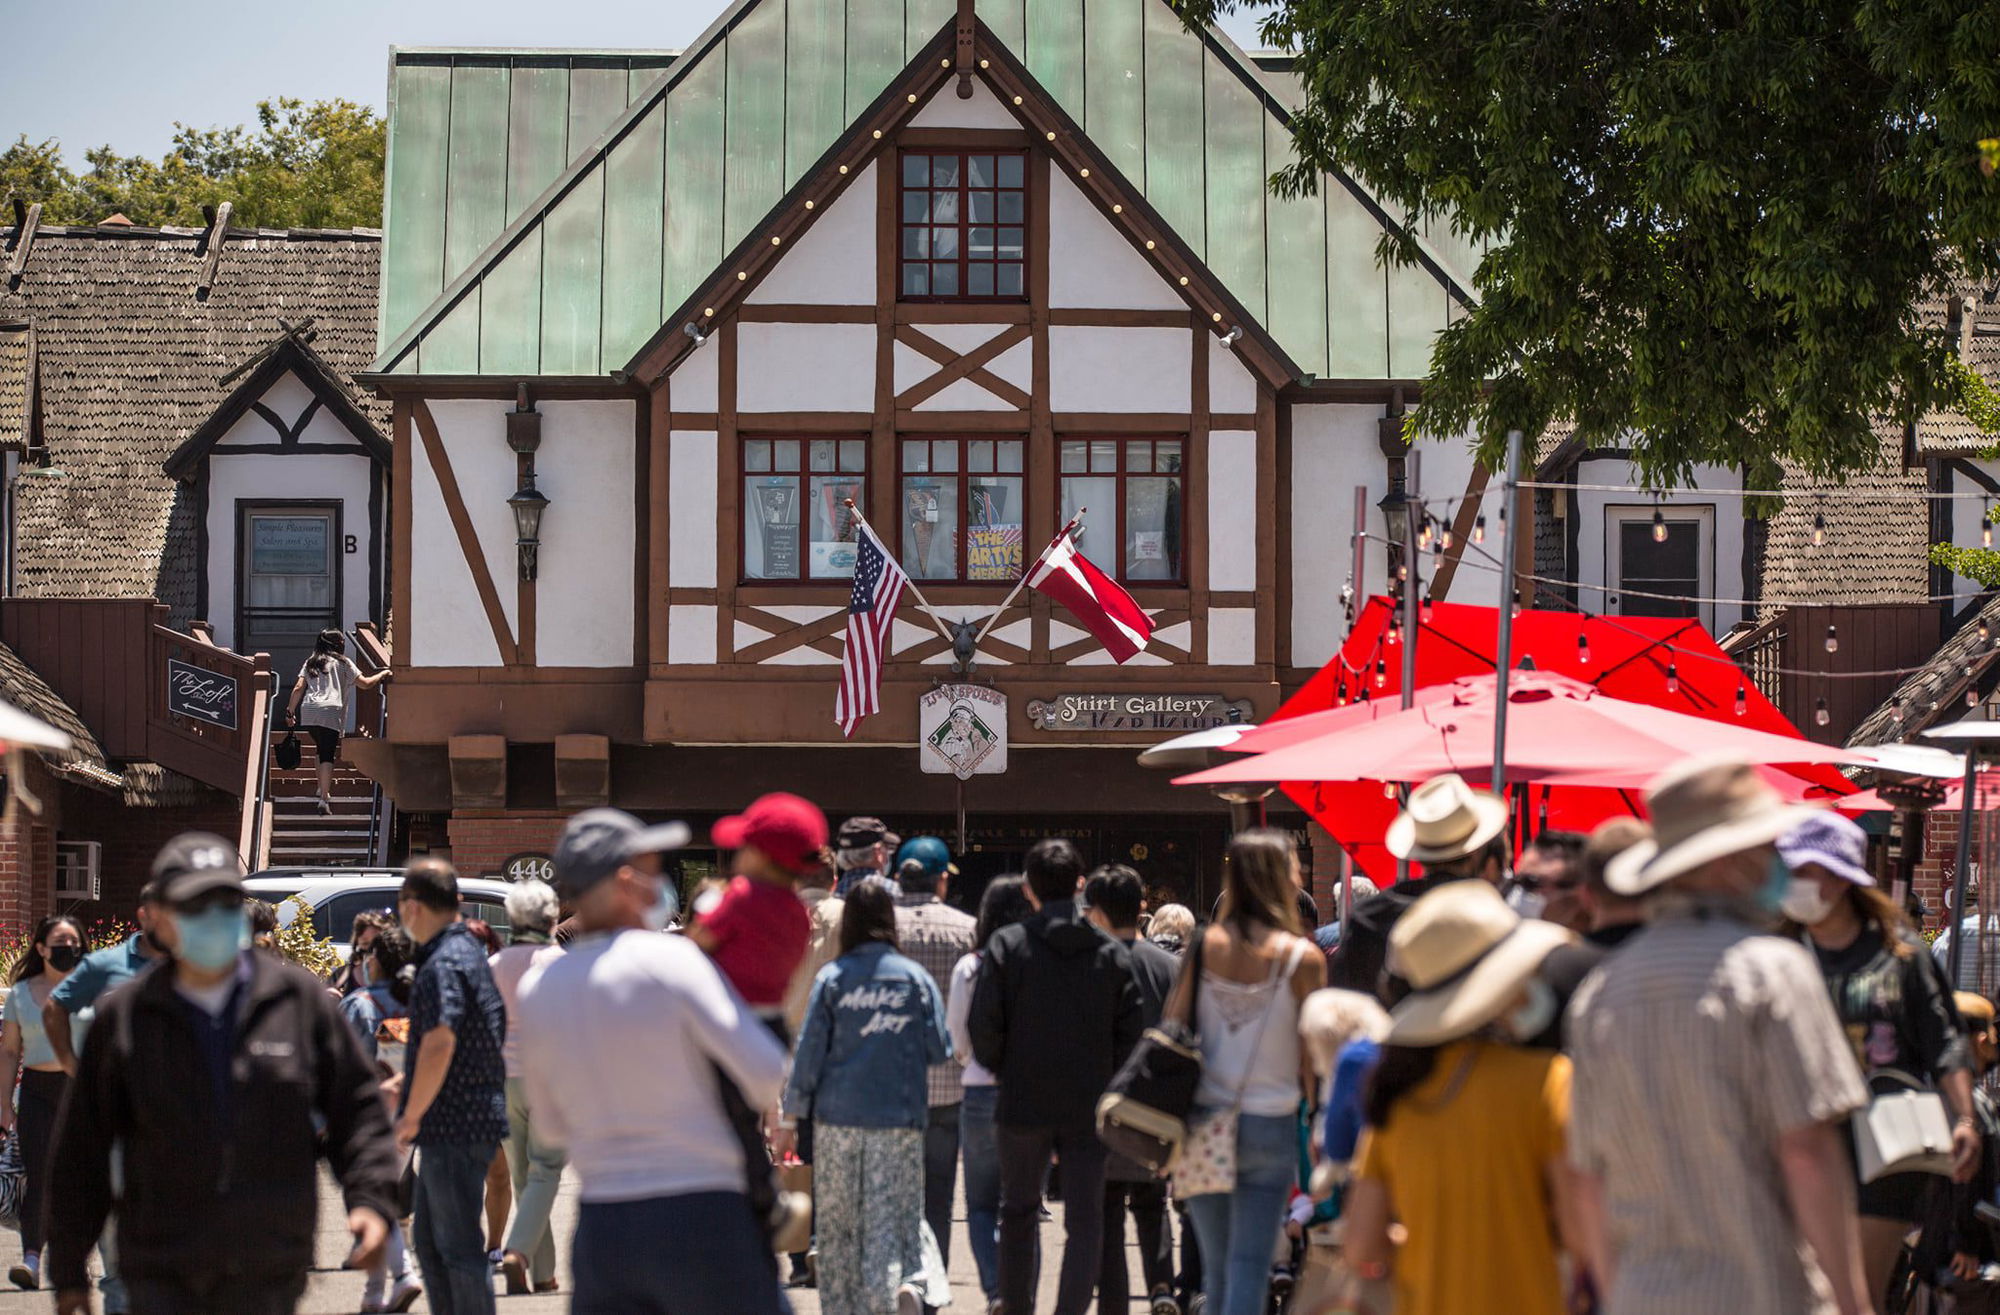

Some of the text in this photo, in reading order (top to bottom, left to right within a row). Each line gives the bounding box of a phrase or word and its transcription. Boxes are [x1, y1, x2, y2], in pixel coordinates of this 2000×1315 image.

[344, 534, 357, 553] B
[975, 531, 1004, 545] THE
[969, 567, 1012, 579] HERE!
[173, 670, 195, 685] The
[179, 680, 233, 703] Loft
[959, 686, 1002, 706] SPORTS
[1061, 695, 1214, 721] Shirt Gallery
[510, 860, 554, 880] 446
